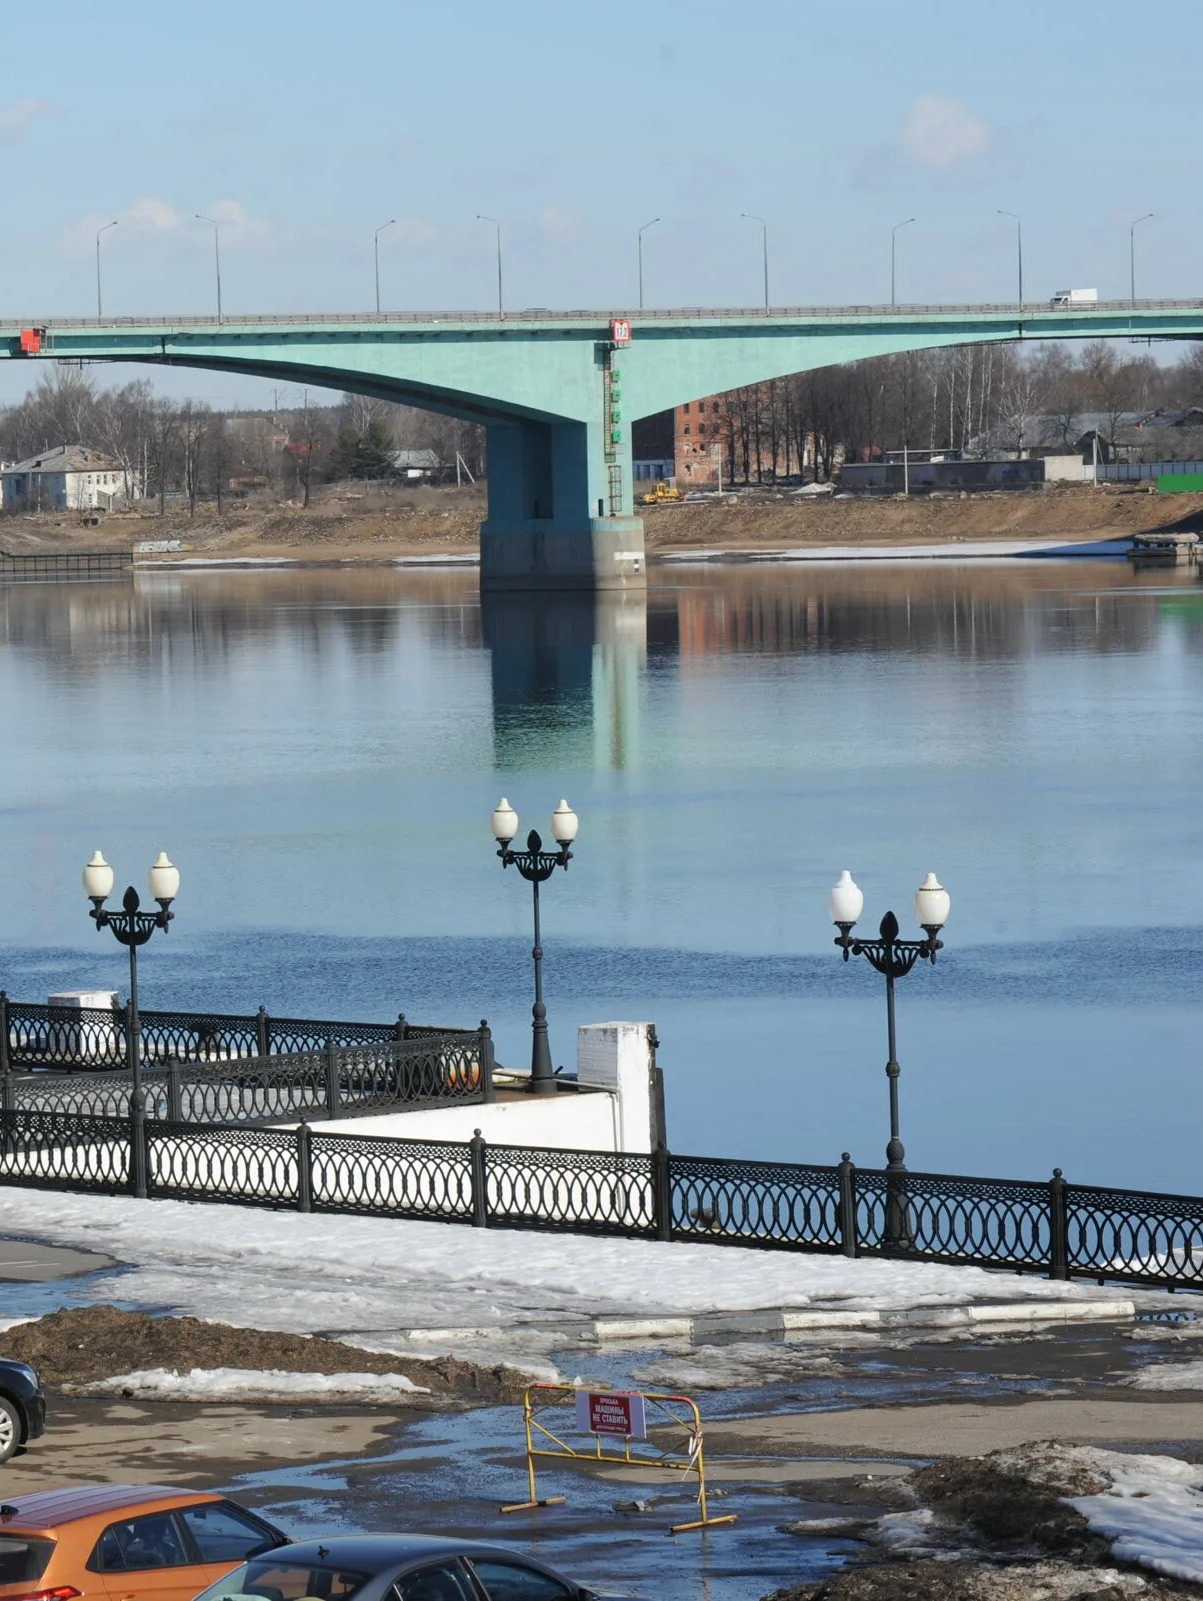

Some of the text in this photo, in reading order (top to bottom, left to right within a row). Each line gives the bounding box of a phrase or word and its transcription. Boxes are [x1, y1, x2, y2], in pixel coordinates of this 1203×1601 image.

[595, 1405, 624, 1415] МАШИНЫ
[592, 1413, 628, 1424] НЕ СТАВИТЬ
